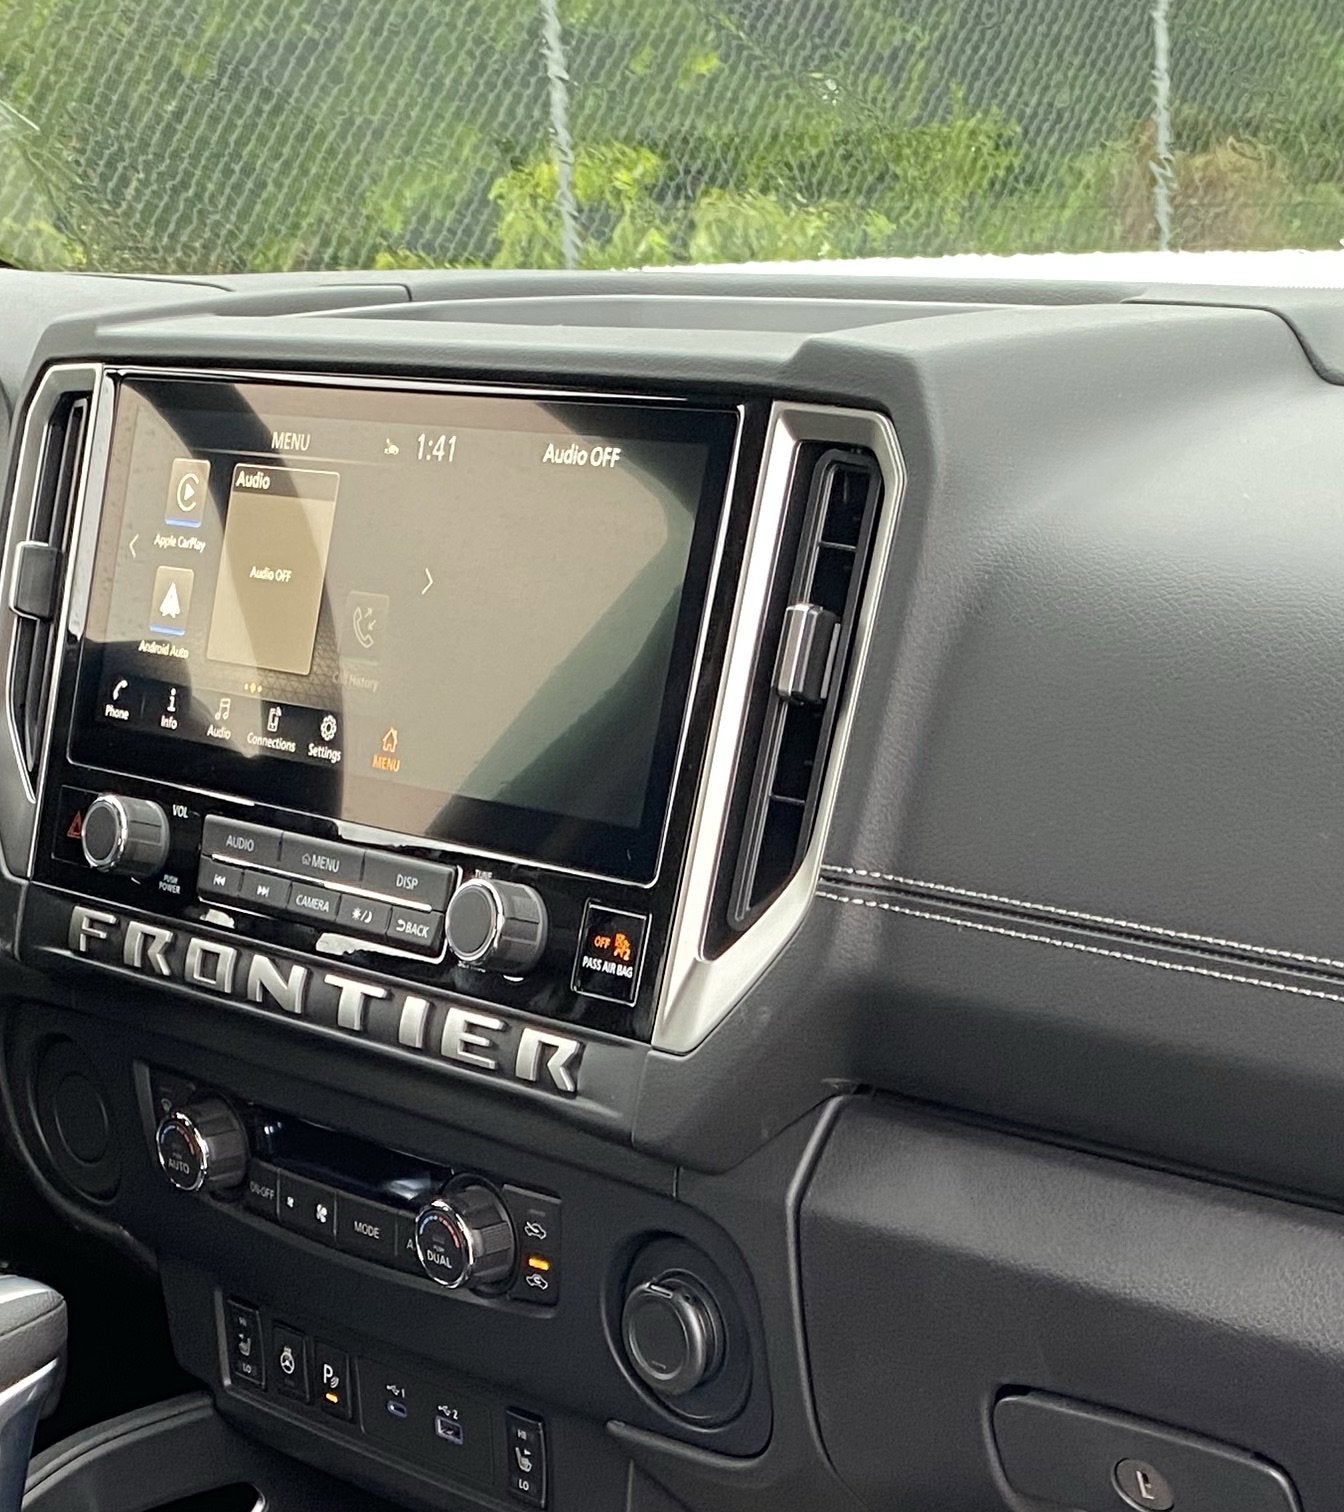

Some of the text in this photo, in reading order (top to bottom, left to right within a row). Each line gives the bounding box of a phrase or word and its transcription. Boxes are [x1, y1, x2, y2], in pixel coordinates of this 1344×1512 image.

[271, 432, 311, 451] MENU
[417, 433, 457, 462] 1:41
[542, 443, 621, 468] Audio OFF
[235, 471, 271, 489] Audio
[154, 534, 205, 553] Apple CarPlay
[250, 566, 292, 582] Audio OFF
[138, 640, 189, 659] Android Auto
[105, 704, 129, 721] Phone
[160, 715, 178, 730] Info
[207, 724, 231, 740] Audio
[247, 732, 296, 753] Connections
[308, 743, 342, 763] Settings
[372, 754, 400, 772] MENU
[172, 804, 188, 818] VOL
[226, 835, 255, 852] AUDIO
[311, 854, 340, 873] MENU
[158, 881, 180, 895] POWER
[396, 874, 418, 890] DISP
[296, 894, 330, 913] CAMERA
[405, 921, 430, 938] BACK
[594, 935, 611, 949] OFF
[582, 956, 633, 978] PASS AIR BAG
[68, 905, 584, 1093] FRONTIER
[168, 1158, 190, 1175] AUTO
[354, 1221, 380, 1239] MODE
[427, 1249, 452, 1269] DUAL
[518, 1478, 529, 1491] LO
